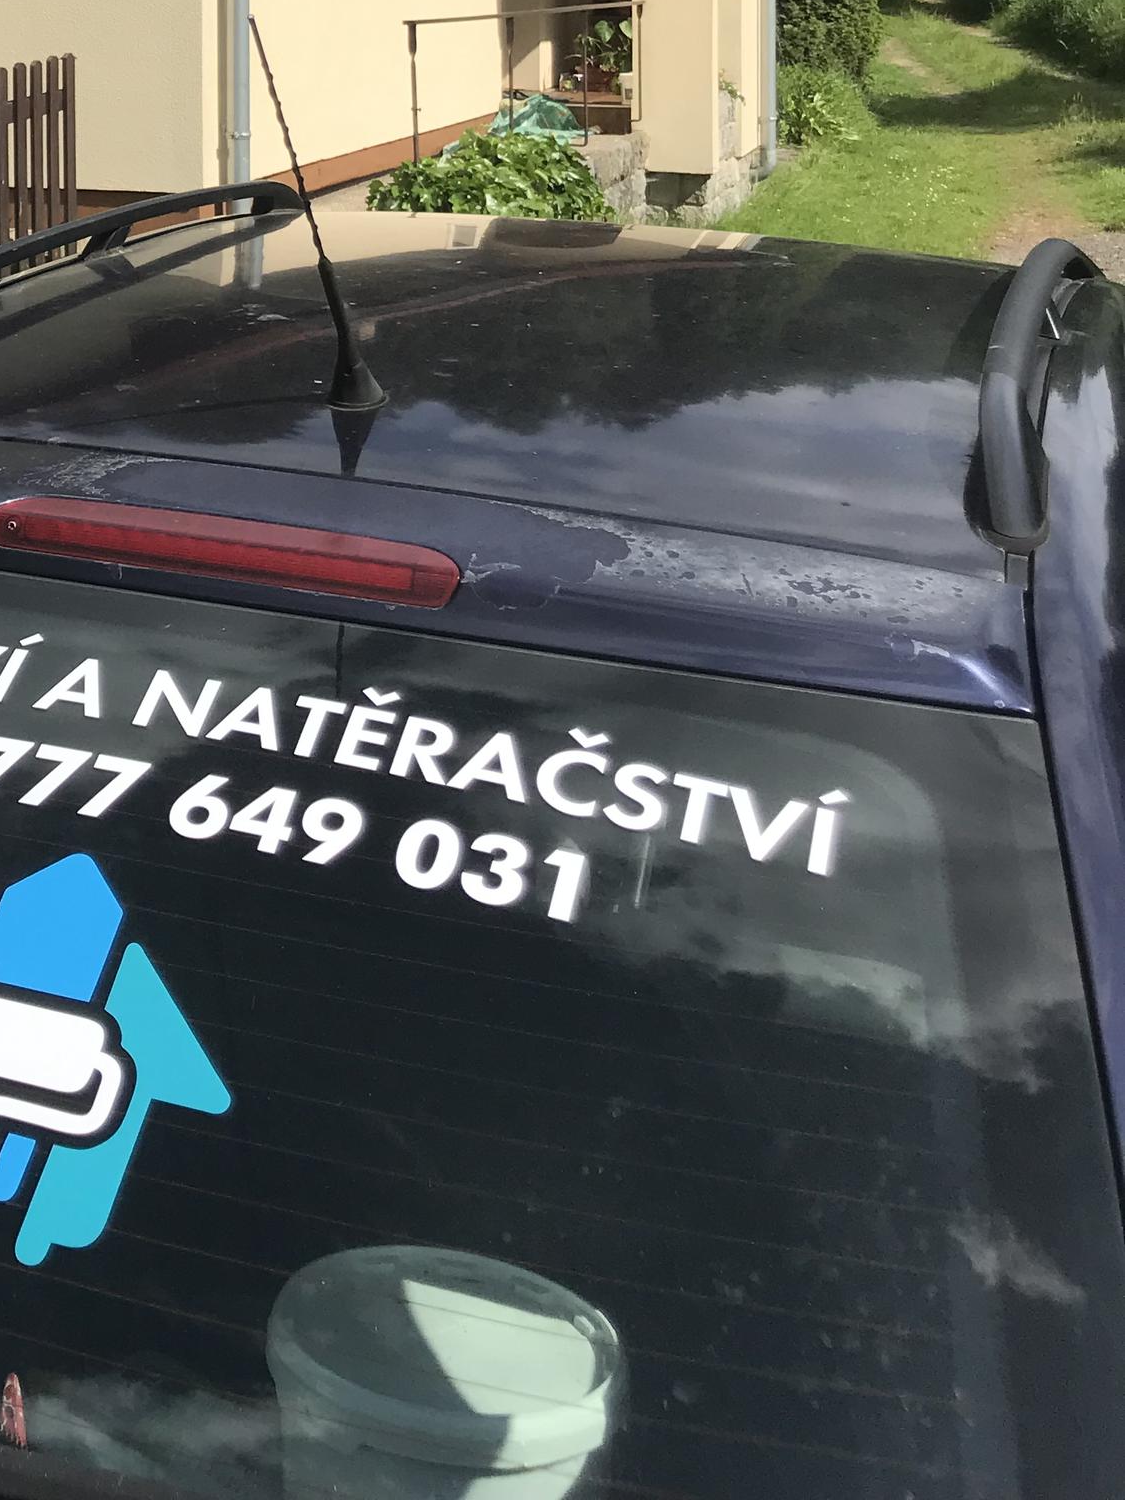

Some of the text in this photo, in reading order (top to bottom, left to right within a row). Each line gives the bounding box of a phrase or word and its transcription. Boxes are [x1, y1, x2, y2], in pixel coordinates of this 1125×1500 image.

[31, 657, 101, 720] A
[130, 667, 854, 877] NATĚRAČSTVÍ
[168, 774, 364, 866] 649
[394, 818, 587, 924] 031
